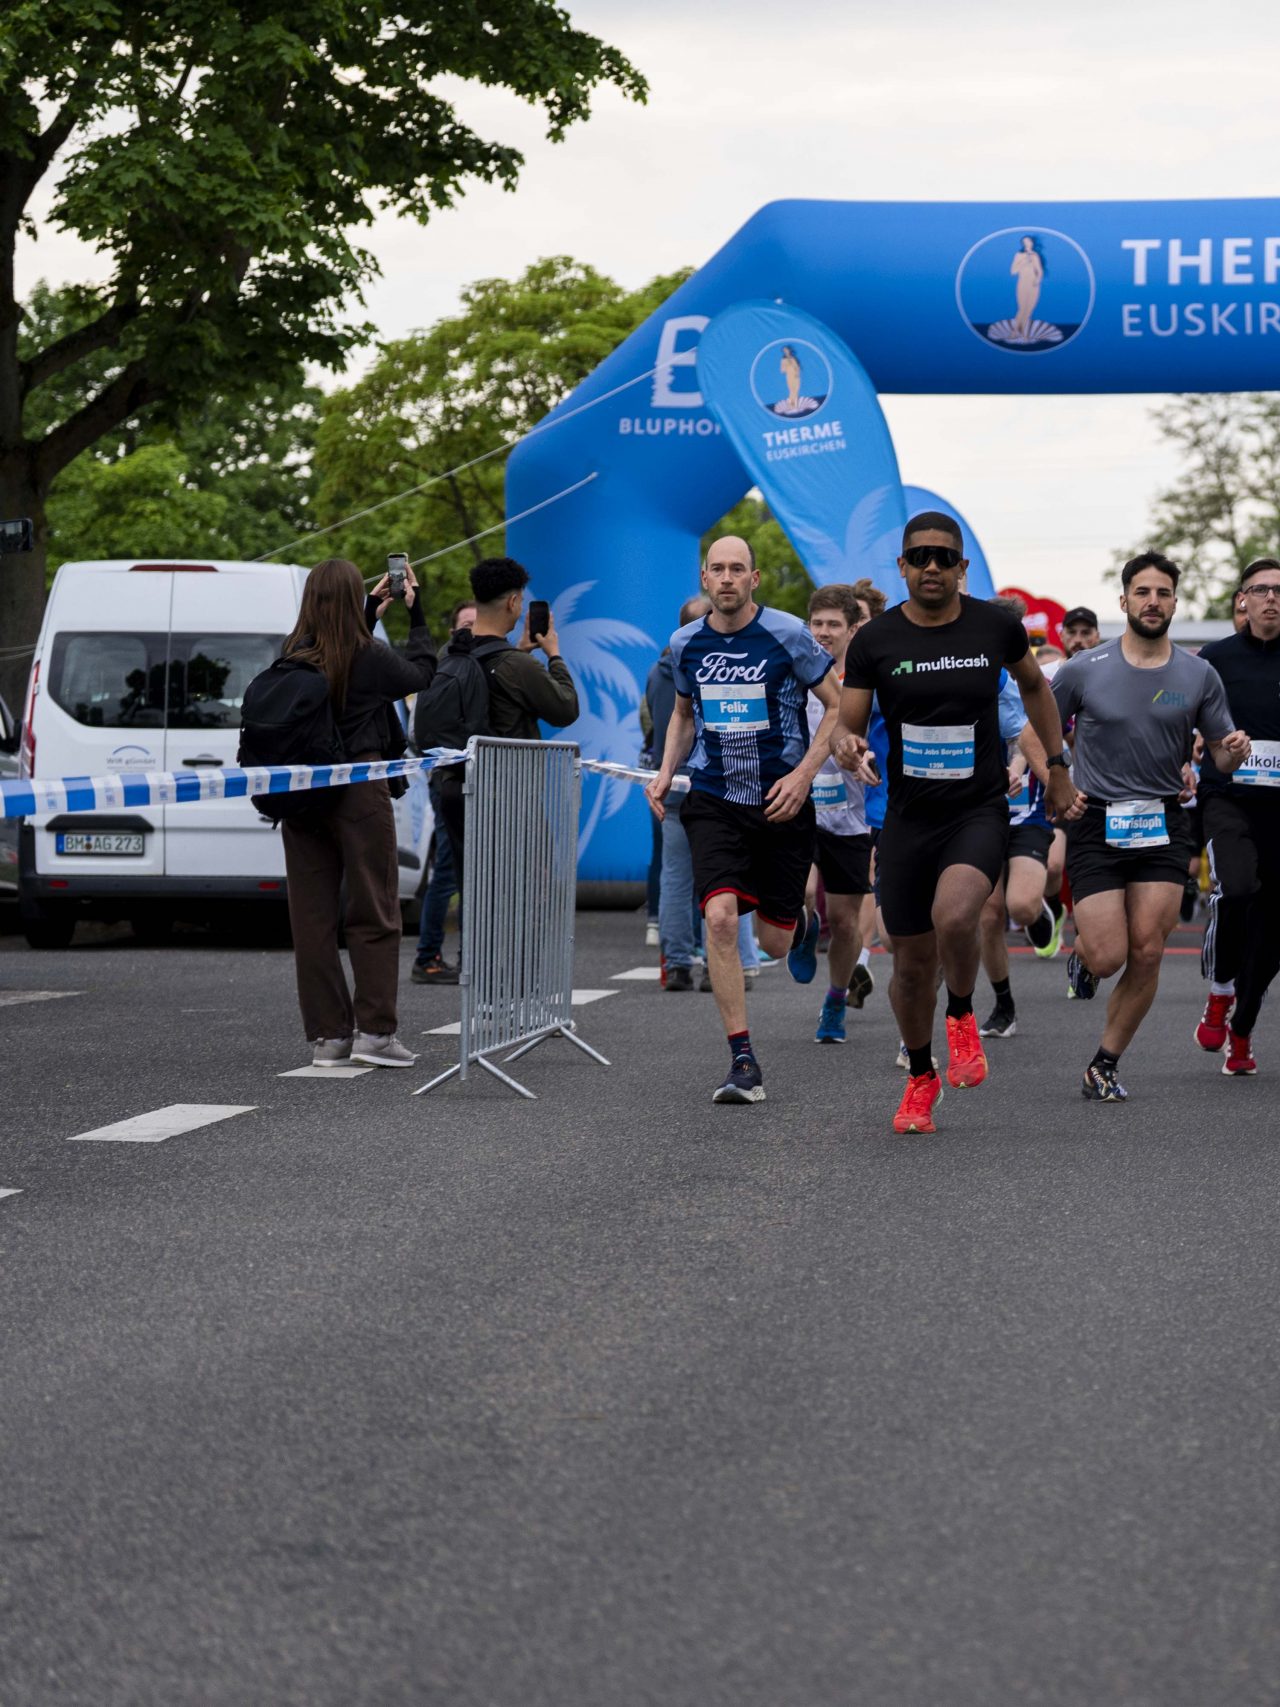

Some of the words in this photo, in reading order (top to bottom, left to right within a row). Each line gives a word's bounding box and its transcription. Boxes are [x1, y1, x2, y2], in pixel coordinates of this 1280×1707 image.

[618, 417, 721, 436] BLUPHO
[763, 421, 843, 447] THERME
[765, 439, 847, 462] EUSKIRCHEN
[695, 652, 768, 683] Ford
[916, 653, 989, 673] multicash
[720, 701, 749, 714] Felix
[812, 787, 838, 799] shua
[1109, 815, 1162, 831] Christoph
[66, 836, 84, 850] BM
[94, 836, 112, 850] AG
[115, 836, 141, 850] 273
